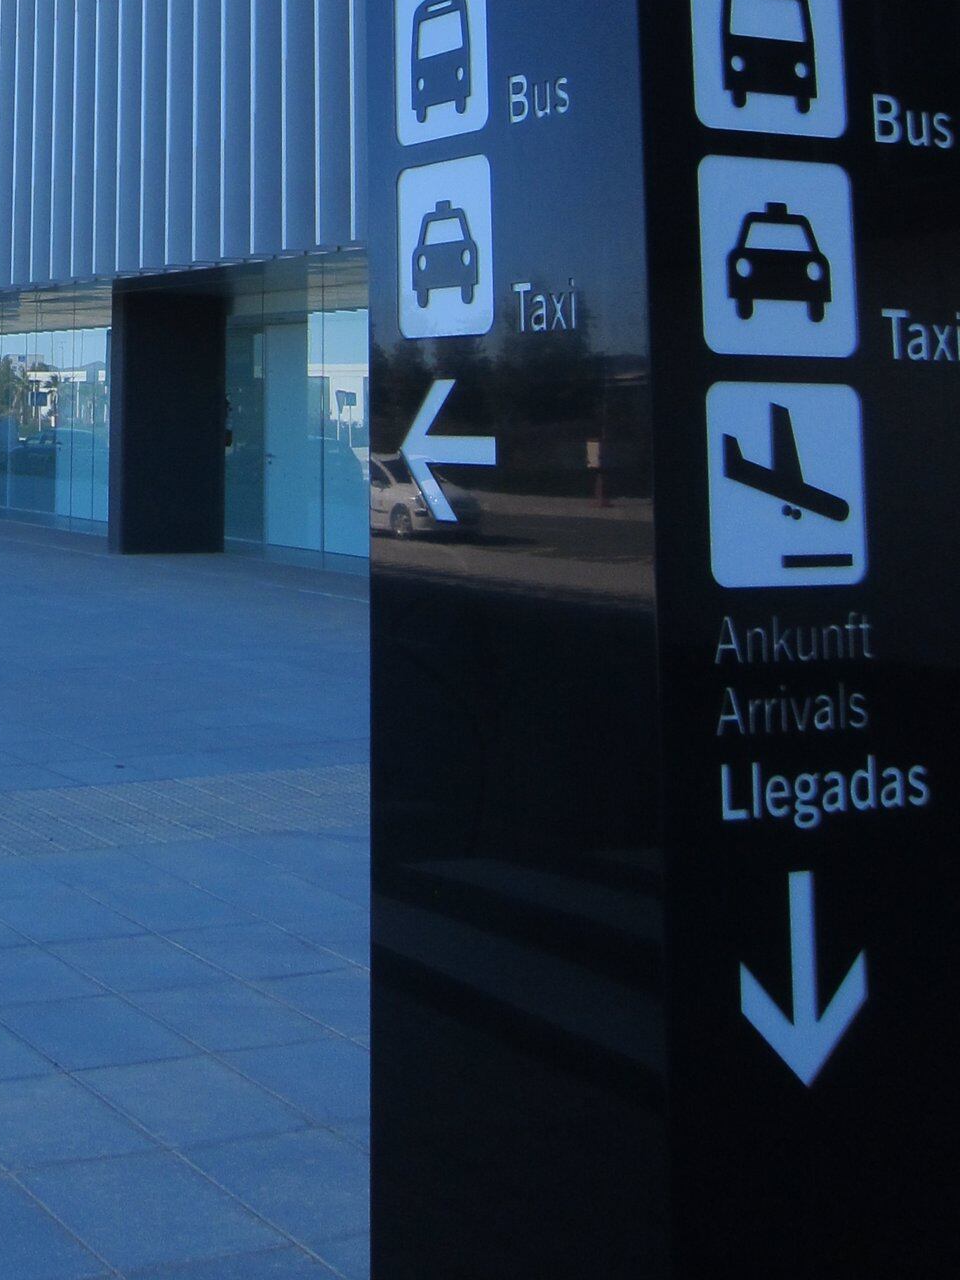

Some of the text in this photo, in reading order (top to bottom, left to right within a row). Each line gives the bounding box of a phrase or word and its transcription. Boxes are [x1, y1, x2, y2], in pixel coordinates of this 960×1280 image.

[508, 74, 570, 123] Bus
[872, 93, 954, 149] Bus
[511, 277, 577, 333] Taxi
[715, 612, 875, 664] Ankunft
[716, 682, 869, 736] Arrivals
[721, 754, 930, 830] Llegadas
